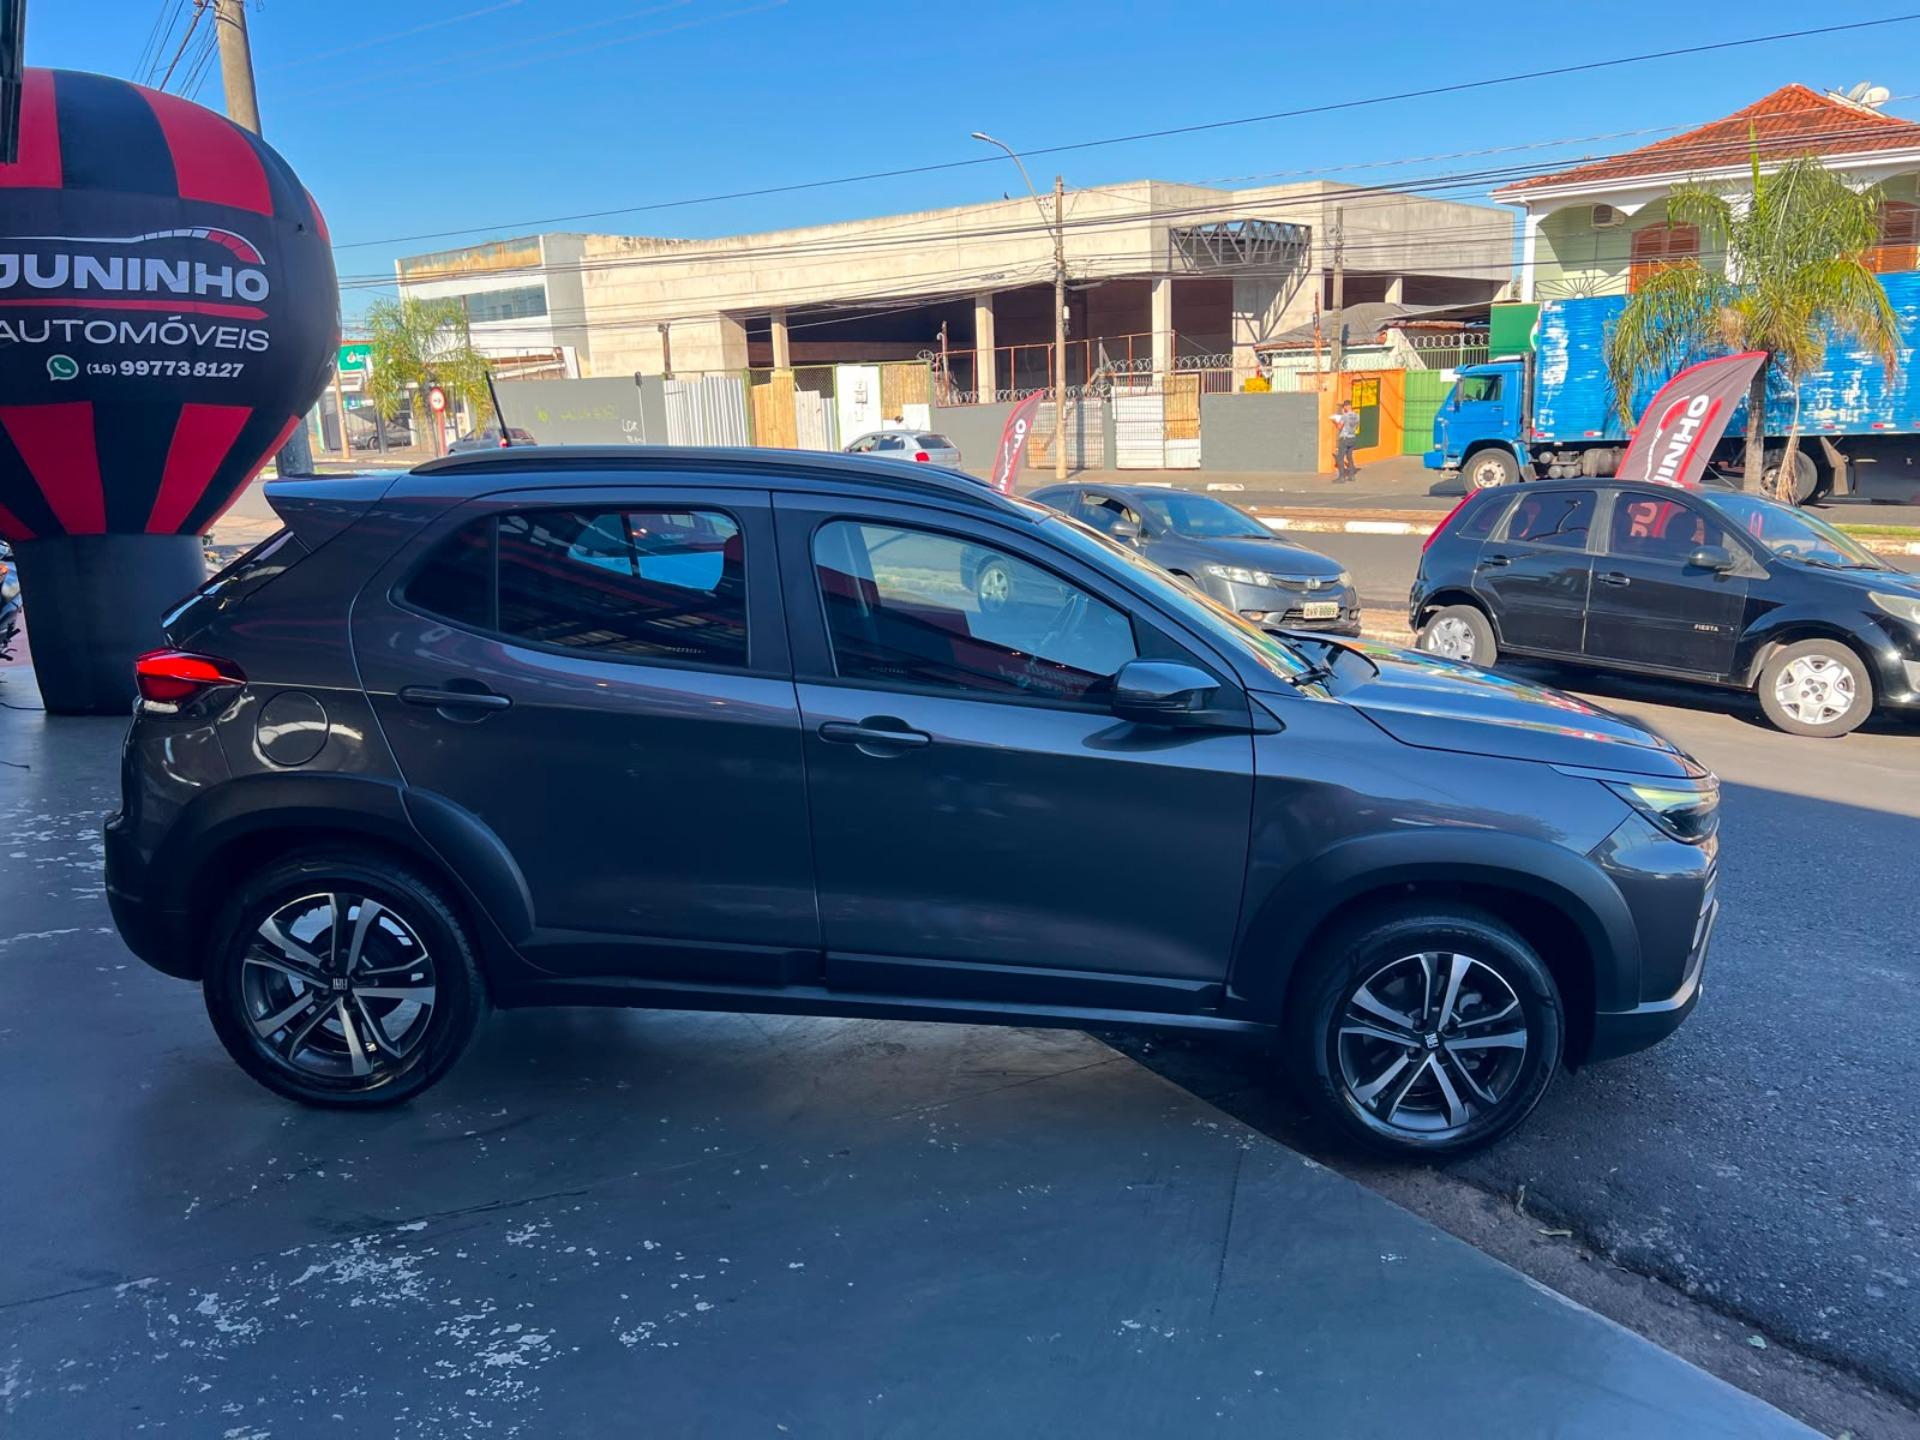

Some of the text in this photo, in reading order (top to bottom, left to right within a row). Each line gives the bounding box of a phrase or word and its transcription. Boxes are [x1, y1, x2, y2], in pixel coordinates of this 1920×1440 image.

[0, 254, 270, 302] JUNINHO
[86, 361, 245, 378] (16) 99773 8127
